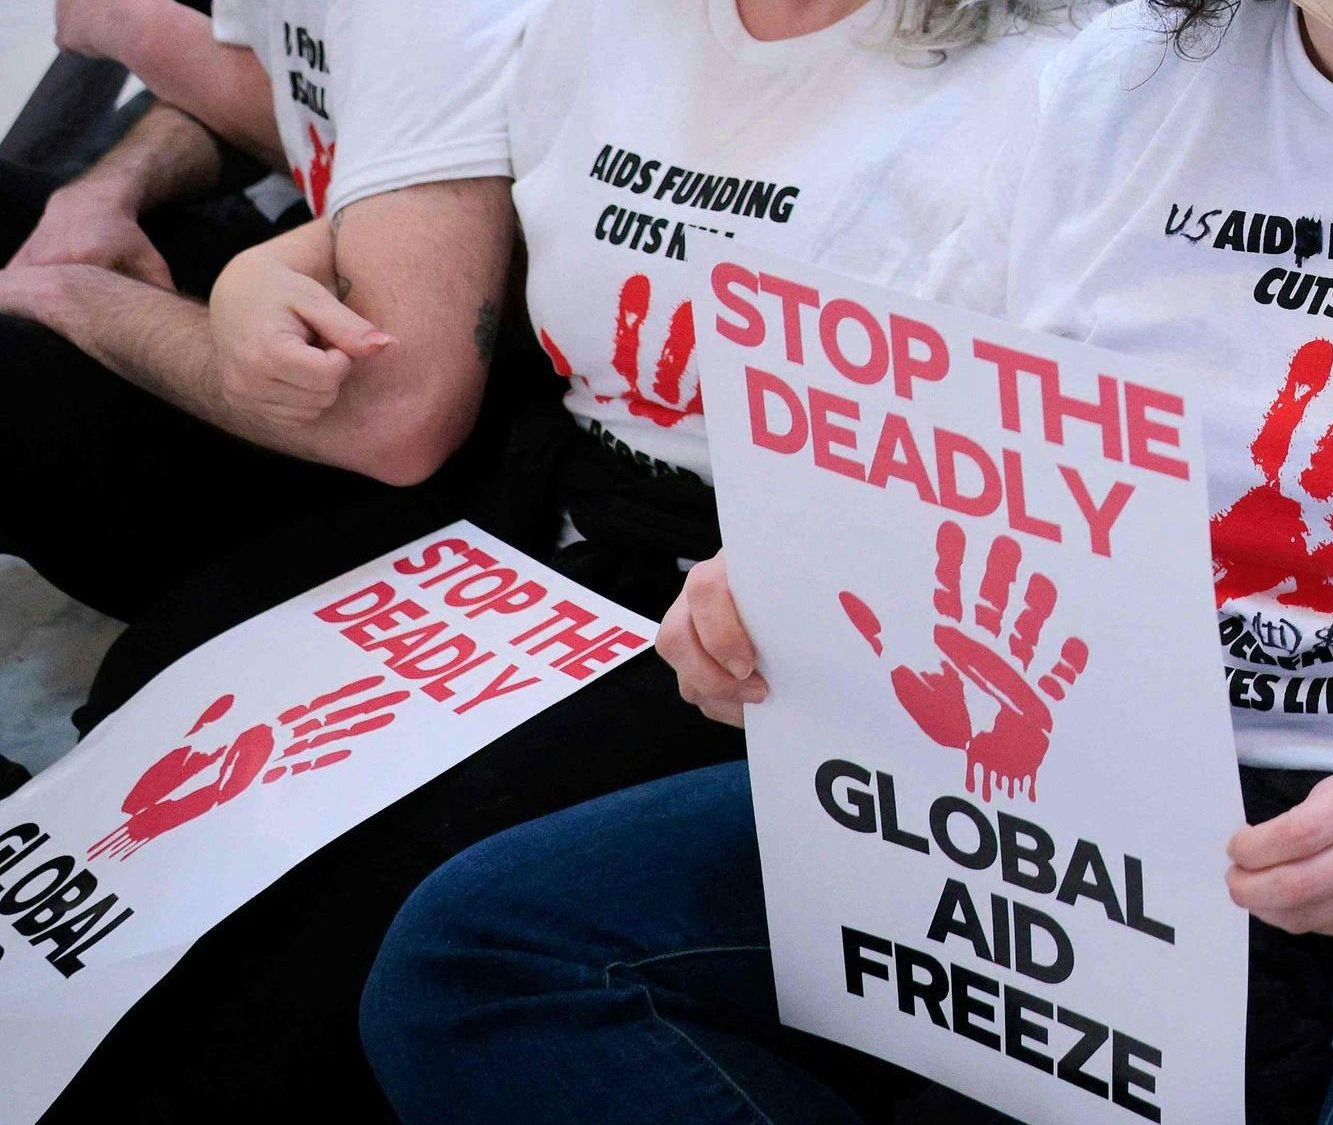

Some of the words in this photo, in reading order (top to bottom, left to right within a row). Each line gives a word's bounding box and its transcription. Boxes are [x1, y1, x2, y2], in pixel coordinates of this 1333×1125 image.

[590, 144, 661, 195] AIDS
[653, 165, 800, 223] FUNDING
[594, 204, 669, 255] CUTS
[710, 262, 950, 401] STOP
[972, 338, 1191, 482] THE
[744, 365, 1137, 558] DEADLY
[313, 581, 542, 715] DEADLY
[392, 538, 549, 620] STOP
[507, 599, 649, 681] THE
[814, 758, 1176, 946] GLOBAL
[926, 877, 1075, 985] AID
[841, 925, 1162, 1125] FREEZE
